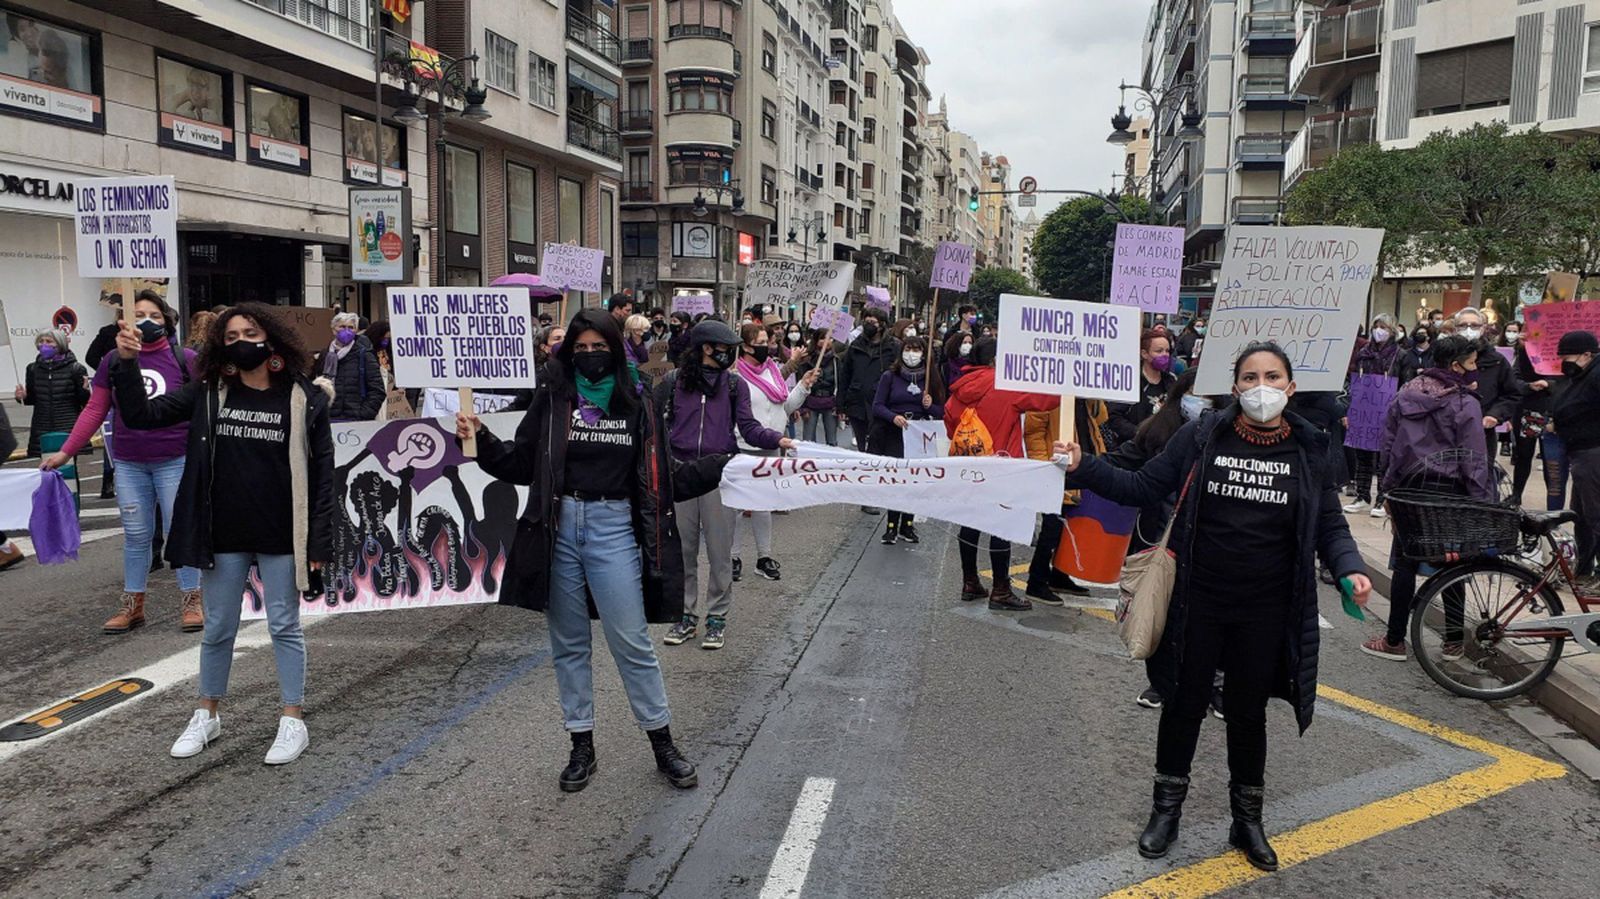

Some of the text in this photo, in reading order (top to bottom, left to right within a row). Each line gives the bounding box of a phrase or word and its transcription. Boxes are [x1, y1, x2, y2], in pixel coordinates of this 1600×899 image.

[4, 86, 46, 106] vivanta
[190, 128, 220, 145] vivanta
[77, 184, 169, 212] LOS FEMINISMOS
[81, 214, 100, 234] SERÁN
[1120, 228, 1134, 240] LES
[95, 240, 102, 268] O
[108, 240, 124, 268] NO
[130, 235, 168, 269] SERÁN
[1118, 246, 1129, 257] DE
[1232, 236, 1360, 263] FALTA VOLUNTAD
[546, 264, 593, 278] TRABAJO
[556, 257, 593, 270] EMPLEO
[1246, 261, 1334, 282] POLÍTICA
[934, 267, 966, 288] LEGAL
[1128, 281, 1160, 304] ACÍ
[1218, 283, 1342, 309] RATIFICACIÓN
[392, 294, 509, 314] NI LAS MUJERES
[414, 316, 526, 336] NI LOS PUEBLOS
[1020, 306, 1118, 340] NUNCA MÁS
[1210, 313, 1324, 338] CONVENIO
[396, 337, 525, 357] SOMOS TERRITORIO
[1034, 336, 1105, 358] CONTARÁN CON
[431, 359, 529, 380] DE CONQUISTA
[1004, 352, 1133, 392] NUESTRO SILENCIO
[432, 392, 454, 412] EL
[473, 397, 510, 414] STAD
[576, 420, 626, 430] ABCIONISTA
[580, 432, 588, 442] DE
[1214, 456, 1290, 476] ABOLICIONISTA
[1228, 470, 1274, 487] DE LA LEY
[1208, 480, 1288, 505] DE EXTRANJERIA
